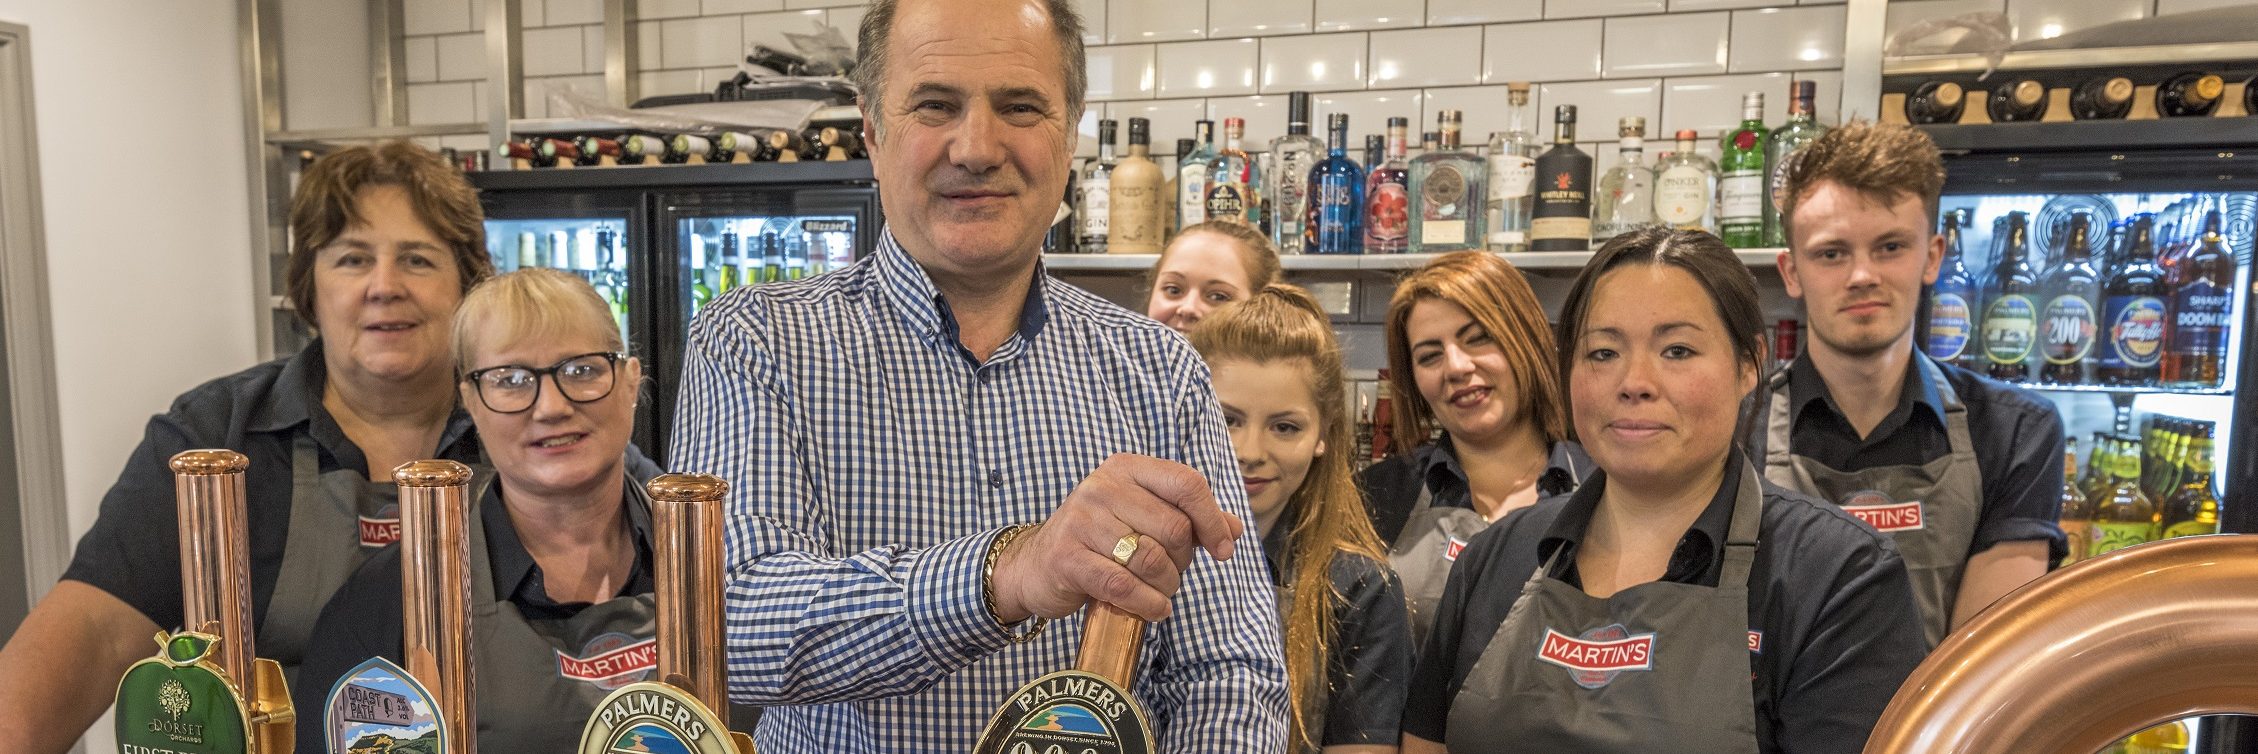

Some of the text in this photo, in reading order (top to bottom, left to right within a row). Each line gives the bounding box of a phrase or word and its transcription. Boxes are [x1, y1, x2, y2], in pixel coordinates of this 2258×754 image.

[1086, 219, 1107, 228] GIN
[2048, 316, 2080, 344] 200
[1854, 508, 1918, 526] RTIN'S
[1547, 637, 1647, 665] MARTIN'S
[348, 687, 381, 708] COAST
[1017, 677, 1128, 722] PALMERS
[350, 703, 376, 719] PATH
[601, 693, 706, 741] PALMERS
[148, 718, 203, 737] DORSET
[170, 734, 202, 744] ORCHARDS
